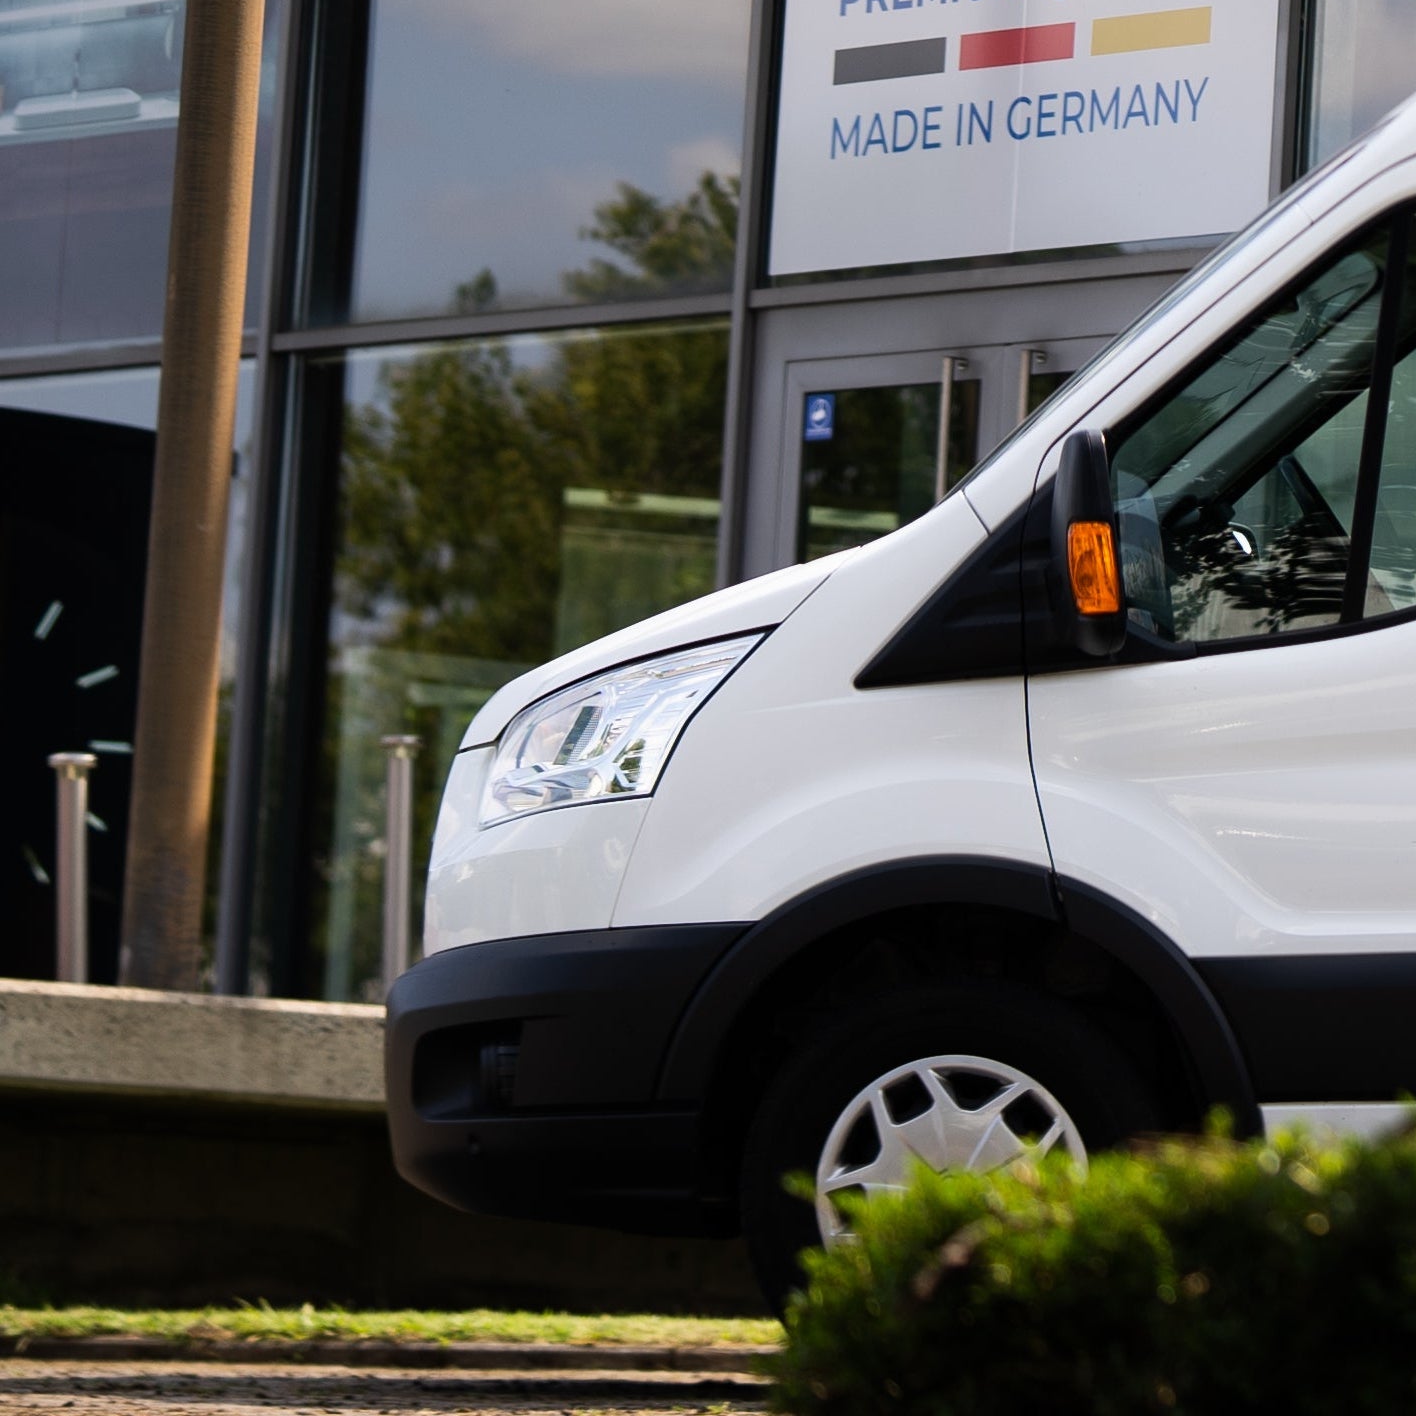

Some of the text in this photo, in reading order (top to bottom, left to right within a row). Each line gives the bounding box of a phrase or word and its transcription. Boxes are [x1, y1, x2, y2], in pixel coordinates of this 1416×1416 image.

[830, 76, 1210, 160] MADE IN GERMANY
